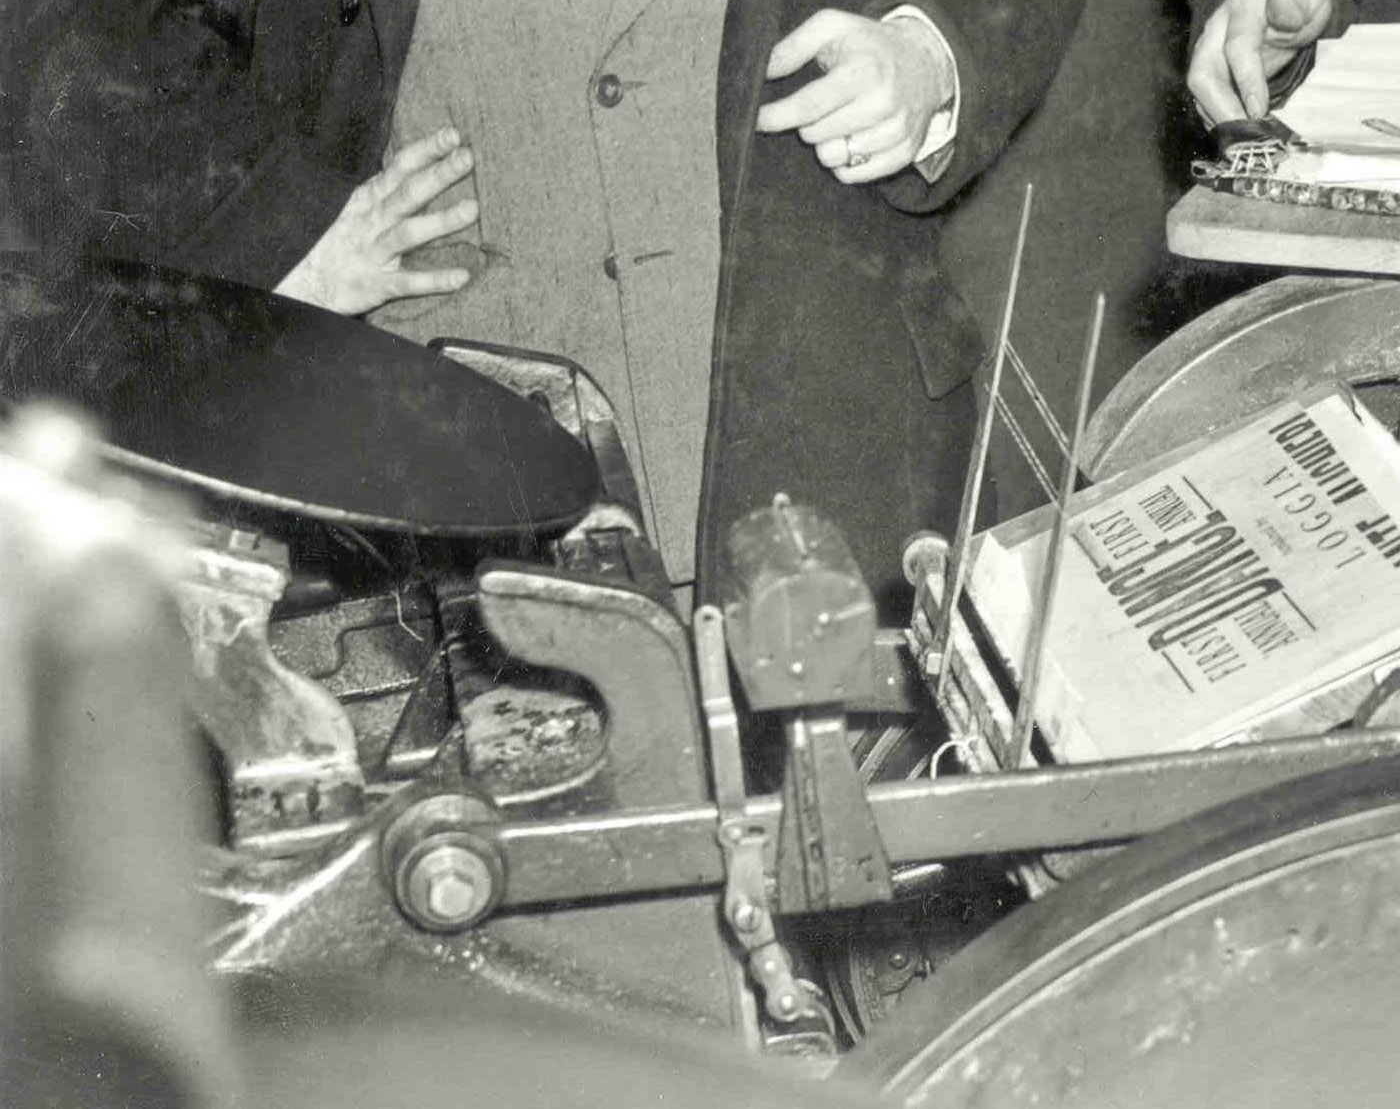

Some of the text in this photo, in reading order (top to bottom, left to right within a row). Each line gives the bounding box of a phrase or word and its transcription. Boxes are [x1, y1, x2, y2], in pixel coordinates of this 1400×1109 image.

[1089, 509, 1149, 560] FIRST
[1138, 484, 1197, 532] ANNUAL
[1263, 465, 1367, 569] LOGGIA
[1097, 509, 1284, 651] DANCE
[1181, 627, 1246, 683] FIRST
[1234, 600, 1299, 658] ANNUAL
